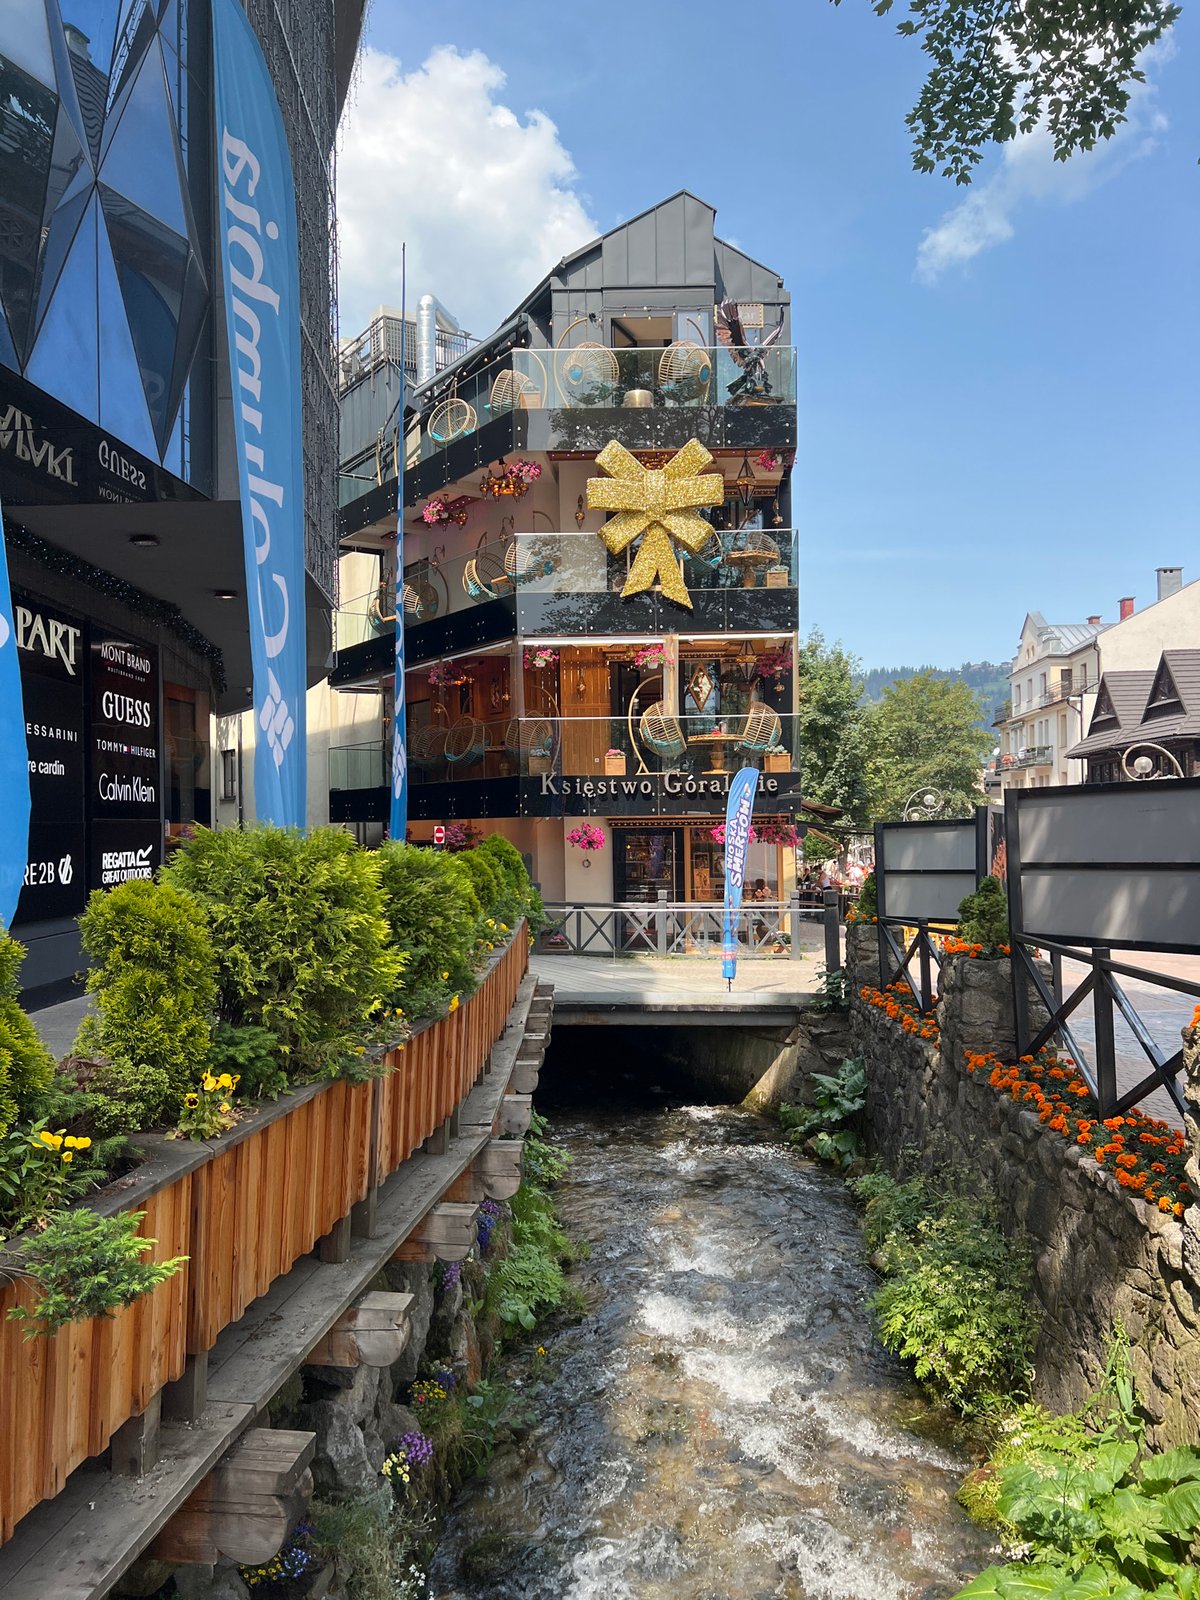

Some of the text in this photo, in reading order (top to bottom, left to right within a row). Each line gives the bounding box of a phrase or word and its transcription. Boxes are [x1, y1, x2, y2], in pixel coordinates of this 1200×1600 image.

[101, 642, 151, 674] MONT BRAND
[102, 690, 151, 728] GUESS
[96, 738, 156, 759] TOMMY HILFIGER
[38, 760, 65, 776] cardin
[98, 772, 155, 803] Calvin Klein
[540, 771, 779, 798] Księstwo Góralie
[727, 818, 738, 870] WIOSKA
[731, 798, 751, 888] SMERFÓW
[102, 851, 136, 870] REGATTA
[102, 867, 152, 884] GREAT OUTDOORS
